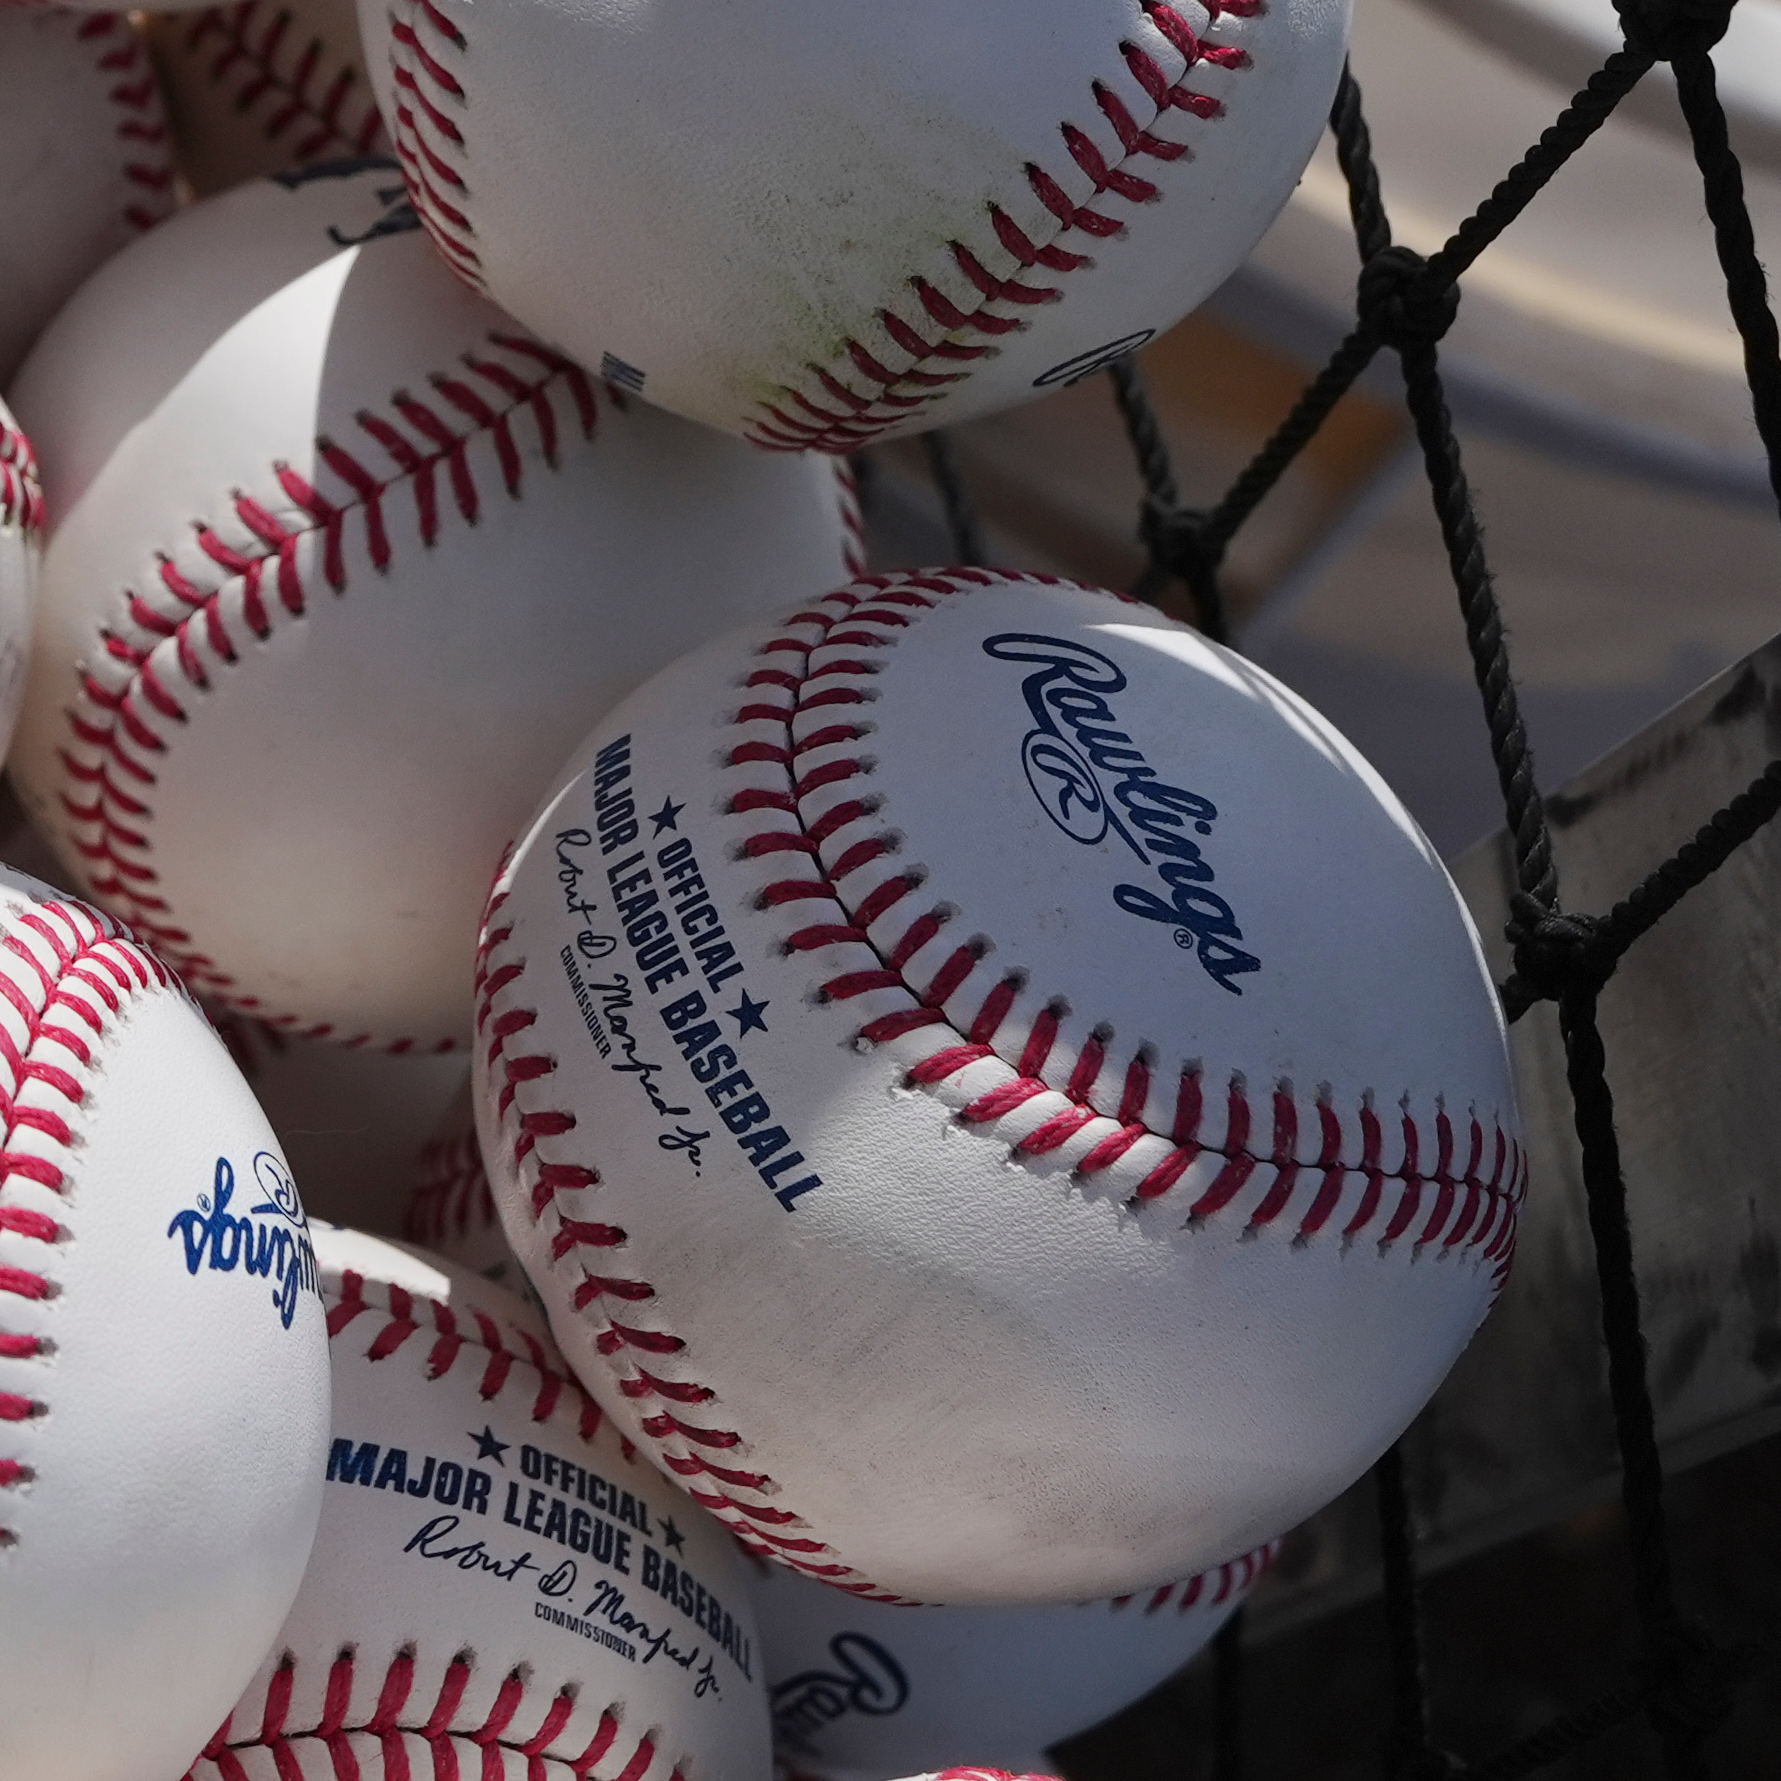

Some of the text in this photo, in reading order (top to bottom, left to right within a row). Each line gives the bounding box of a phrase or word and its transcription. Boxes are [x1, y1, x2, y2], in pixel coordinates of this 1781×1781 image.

[982, 632, 1262, 997] Rawlings
[594, 733, 824, 1213] MAJOR LEAGUE BASEBALL
[656, 837, 745, 994] OFFICIAL
[560, 944, 612, 1060] COMMISSIONER
[326, 1436, 754, 1682] MAJOR LEAGUE BASEBALL
[518, 1444, 653, 1537] OFFICIAL
[534, 1601, 637, 1662] COMMISSIONER
